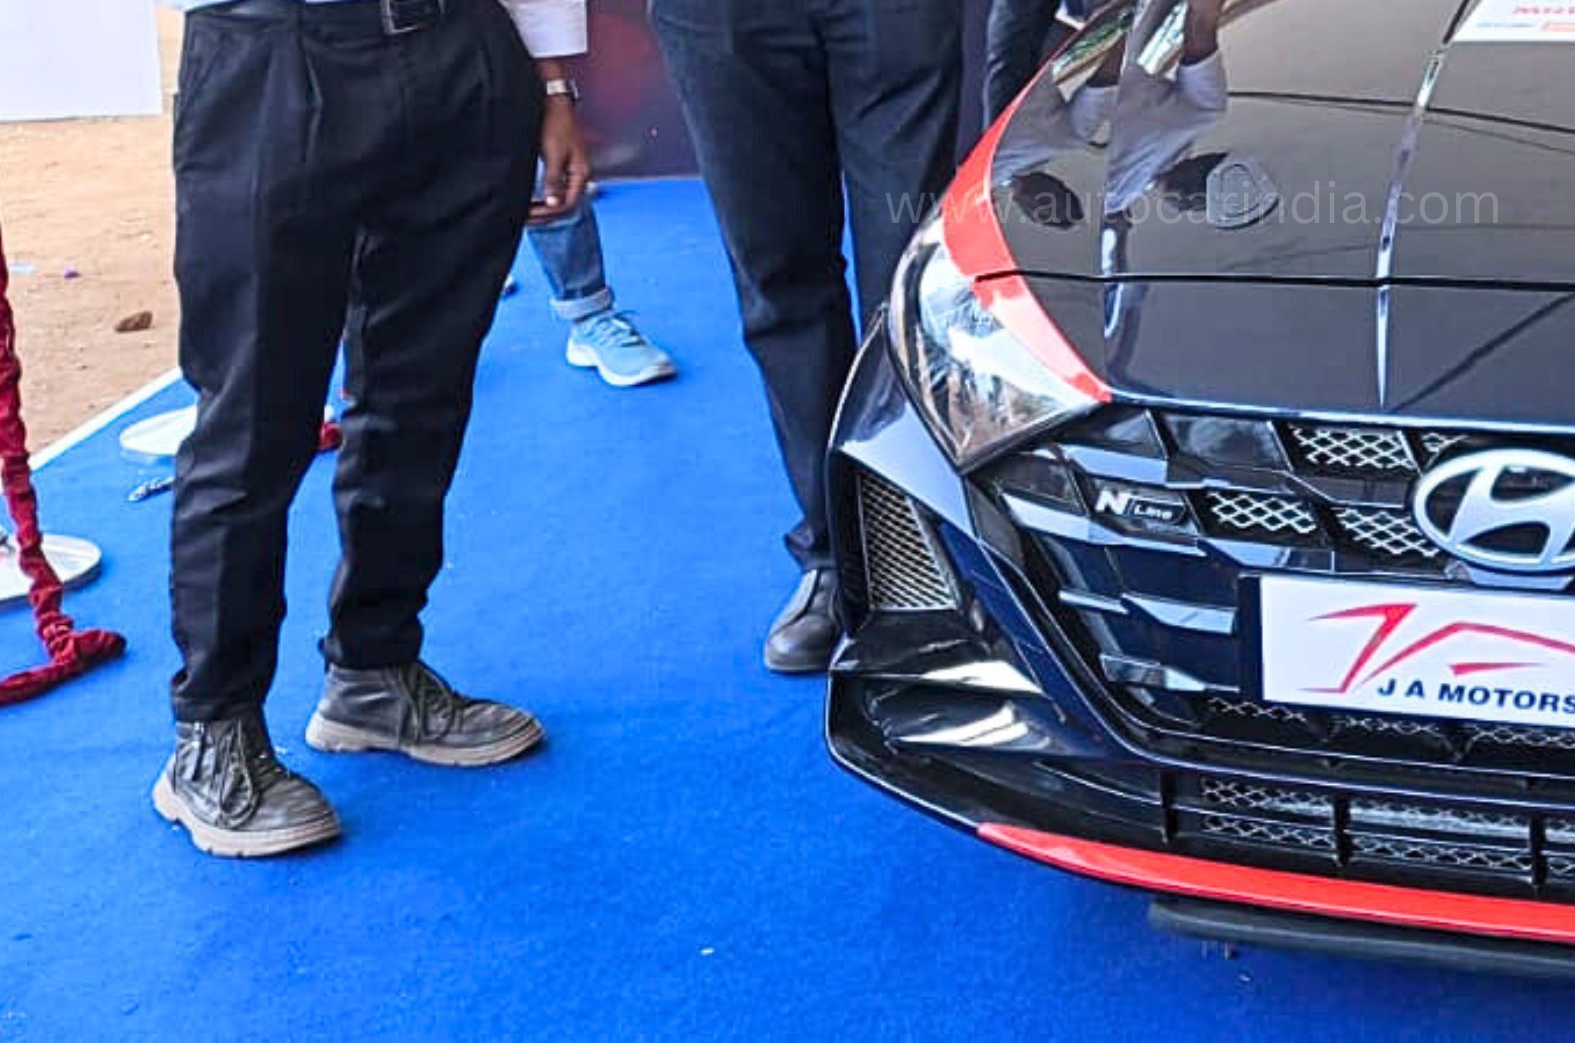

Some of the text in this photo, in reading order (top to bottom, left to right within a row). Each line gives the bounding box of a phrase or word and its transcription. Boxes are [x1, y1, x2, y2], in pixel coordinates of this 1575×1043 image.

[1097, 491, 1172, 520] N Line
[1377, 679, 1396, 697] J
[1404, 680, 1426, 699] A
